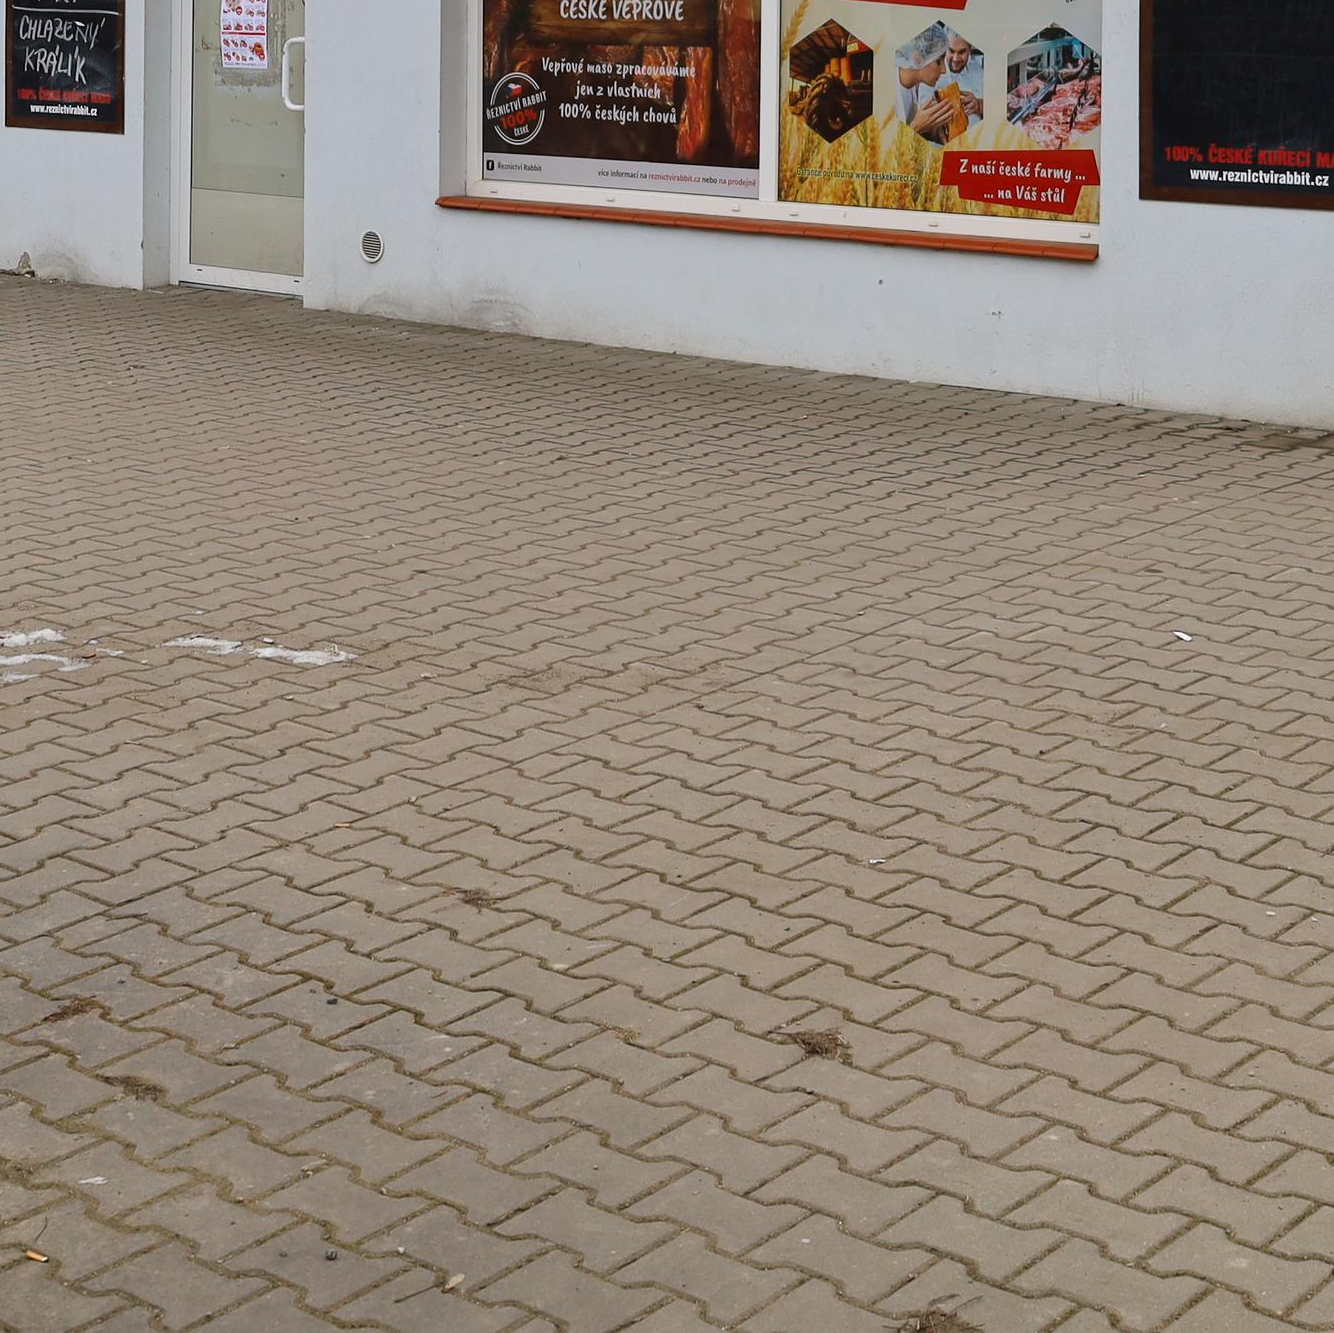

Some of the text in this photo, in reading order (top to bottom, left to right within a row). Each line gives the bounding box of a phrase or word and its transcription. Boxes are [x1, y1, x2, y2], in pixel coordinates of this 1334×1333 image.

[25, 44, 87, 85] KRÁLÍK
[542, 57, 696, 79] Vepřové maso zpracováváme
[574, 79, 661, 100] jen z vlastních
[30, 103, 97, 116] www.reznictvirabbit.cz
[486, 91, 547, 120] ŘEZNICTVÍ RABBIT
[558, 103, 677, 125] 100% českých chovů
[501, 108, 537, 128] 100%
[1164, 146, 1203, 162] 100%
[1208, 143, 1253, 164] ČESKÉ
[1258, 145, 1311, 167] KUŘECÍ
[498, 161, 522, 171] Řeznictví
[523, 163, 542, 172] Rabbit
[959, 159, 968, 173] Z
[971, 160, 996, 175] naší
[999, 161, 1031, 177] české
[1034, 163, 1072, 183] farmy
[598, 169, 610, 177] více
[610, 170, 639, 179] informací
[648, 172, 701, 183] reznictvirabbit.cz
[702, 176, 717, 184] nebo
[727, 177, 756, 187] prodejně
[1190, 168, 1329, 187] www.reznictvirabbit.cz
[997, 188, 1012, 199] na
[1016, 185, 1037, 201] Váš
[1040, 187, 1065, 203] stůl
